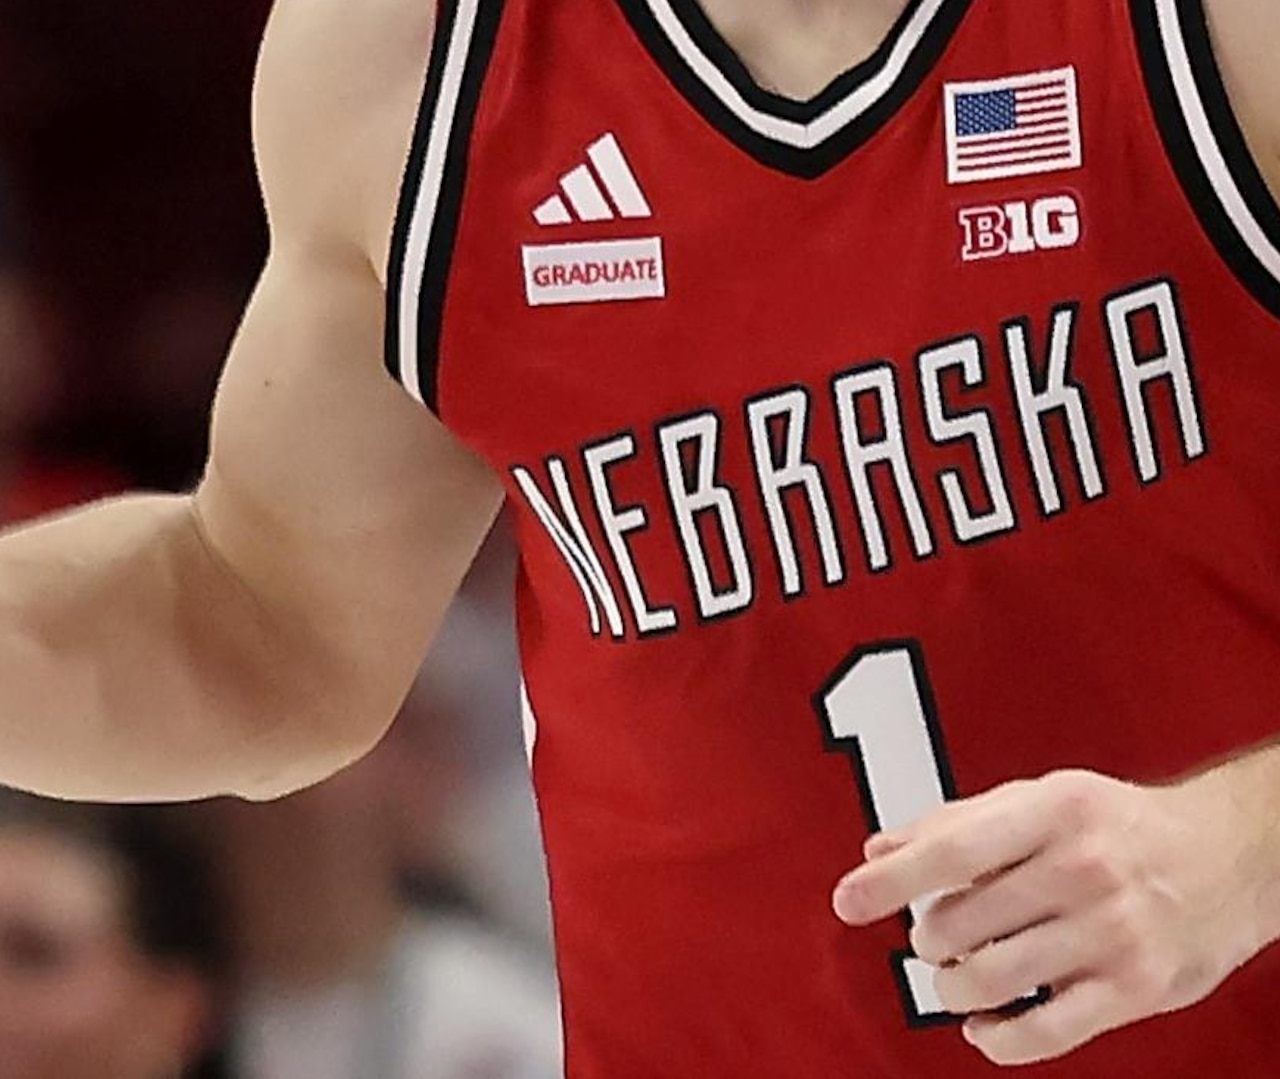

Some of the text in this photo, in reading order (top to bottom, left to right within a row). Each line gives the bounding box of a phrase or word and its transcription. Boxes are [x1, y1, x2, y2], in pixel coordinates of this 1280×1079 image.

[533, 257, 657, 287] GRADUATE
[511, 277, 1208, 640] NEBRASKA
[811, 637, 1052, 1029] 1
